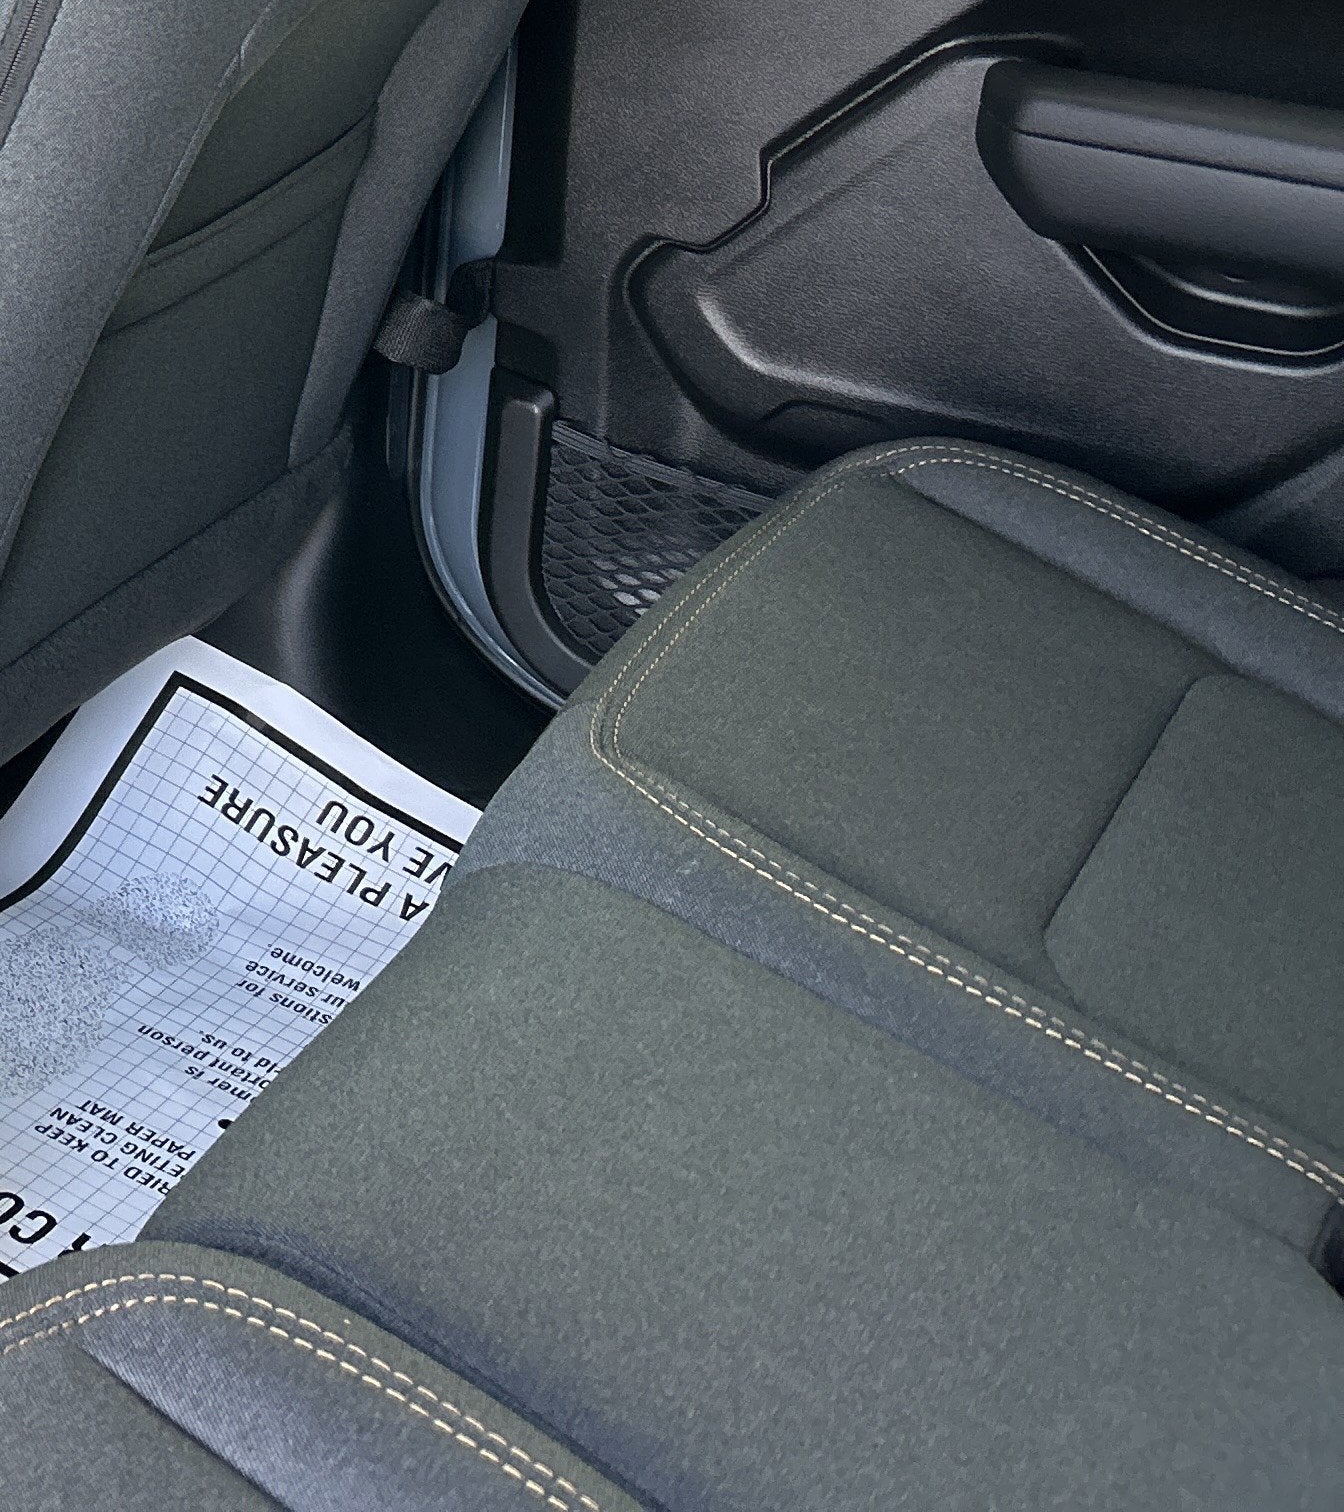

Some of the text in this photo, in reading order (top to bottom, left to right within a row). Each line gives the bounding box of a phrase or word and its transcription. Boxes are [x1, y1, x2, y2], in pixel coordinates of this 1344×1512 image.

[197, 774, 431, 922] A PLEASURE
[316, 800, 395, 863] YOU
[237, 979, 262, 998] for
[245, 960, 346, 1008] ur service
[268, 944, 361, 992] welcome.
[137, 1024, 210, 1061] person
[198, 1030, 282, 1074] ld to us.
[185, 1066, 205, 1080] is
[34, 1124, 90, 1153] KEEP
[49, 1107, 185, 1178] ETING CLEAN
[76, 1099, 197, 1161] PAPER MAT
[91, 1149, 120, 1170] TO
